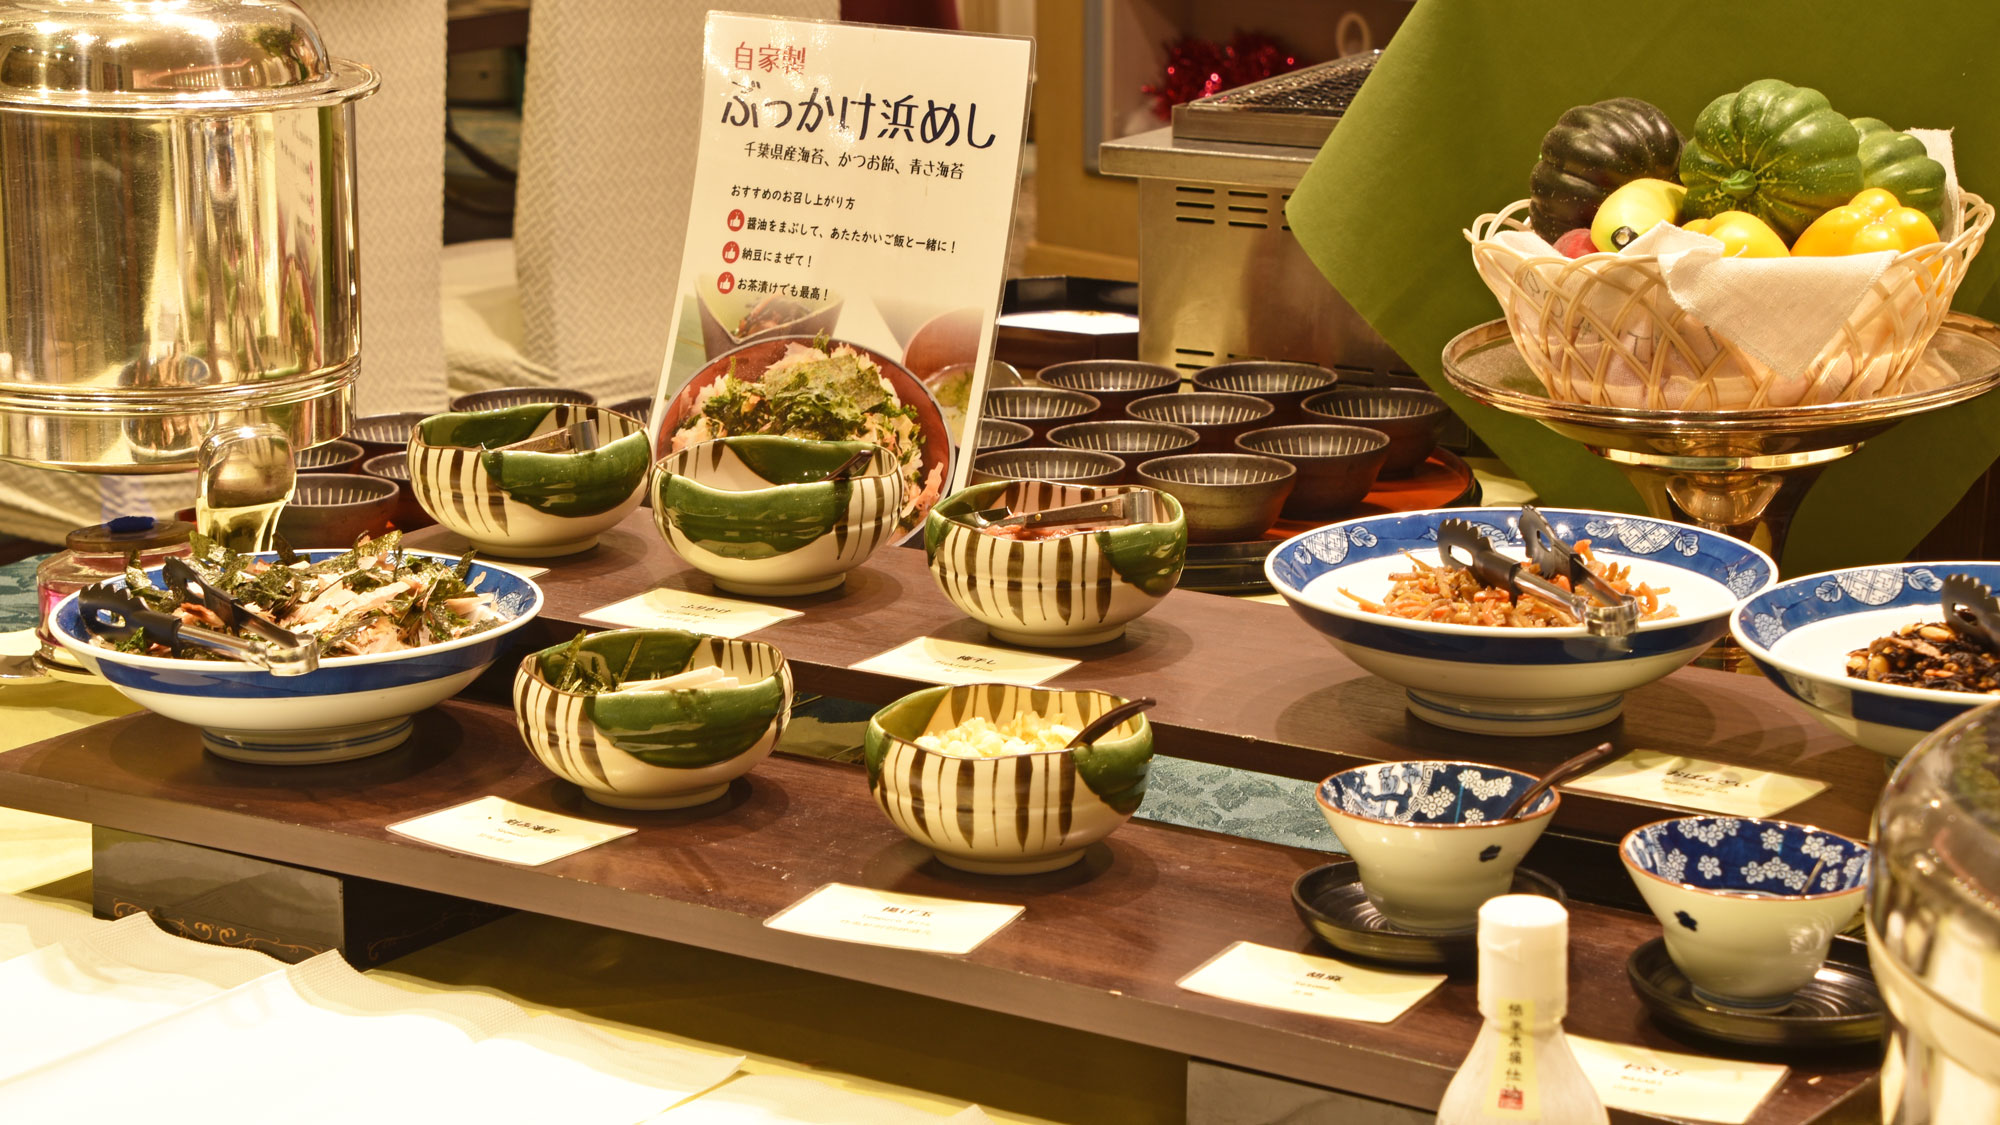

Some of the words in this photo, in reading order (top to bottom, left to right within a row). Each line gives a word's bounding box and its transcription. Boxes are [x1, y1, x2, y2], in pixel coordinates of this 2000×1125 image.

[734, 41, 806, 75] 自家製
[721, 81, 996, 149] ぶっかけ浜めし
[744, 141, 964, 180] 千葉県産海苔、かつお節、青さ海苔
[731, 184, 855, 210] おすすめのお召し上がり方
[742, 247, 812, 267] 納豆にまぜて！
[737, 278, 828, 301] お茶漬けでも最高！
